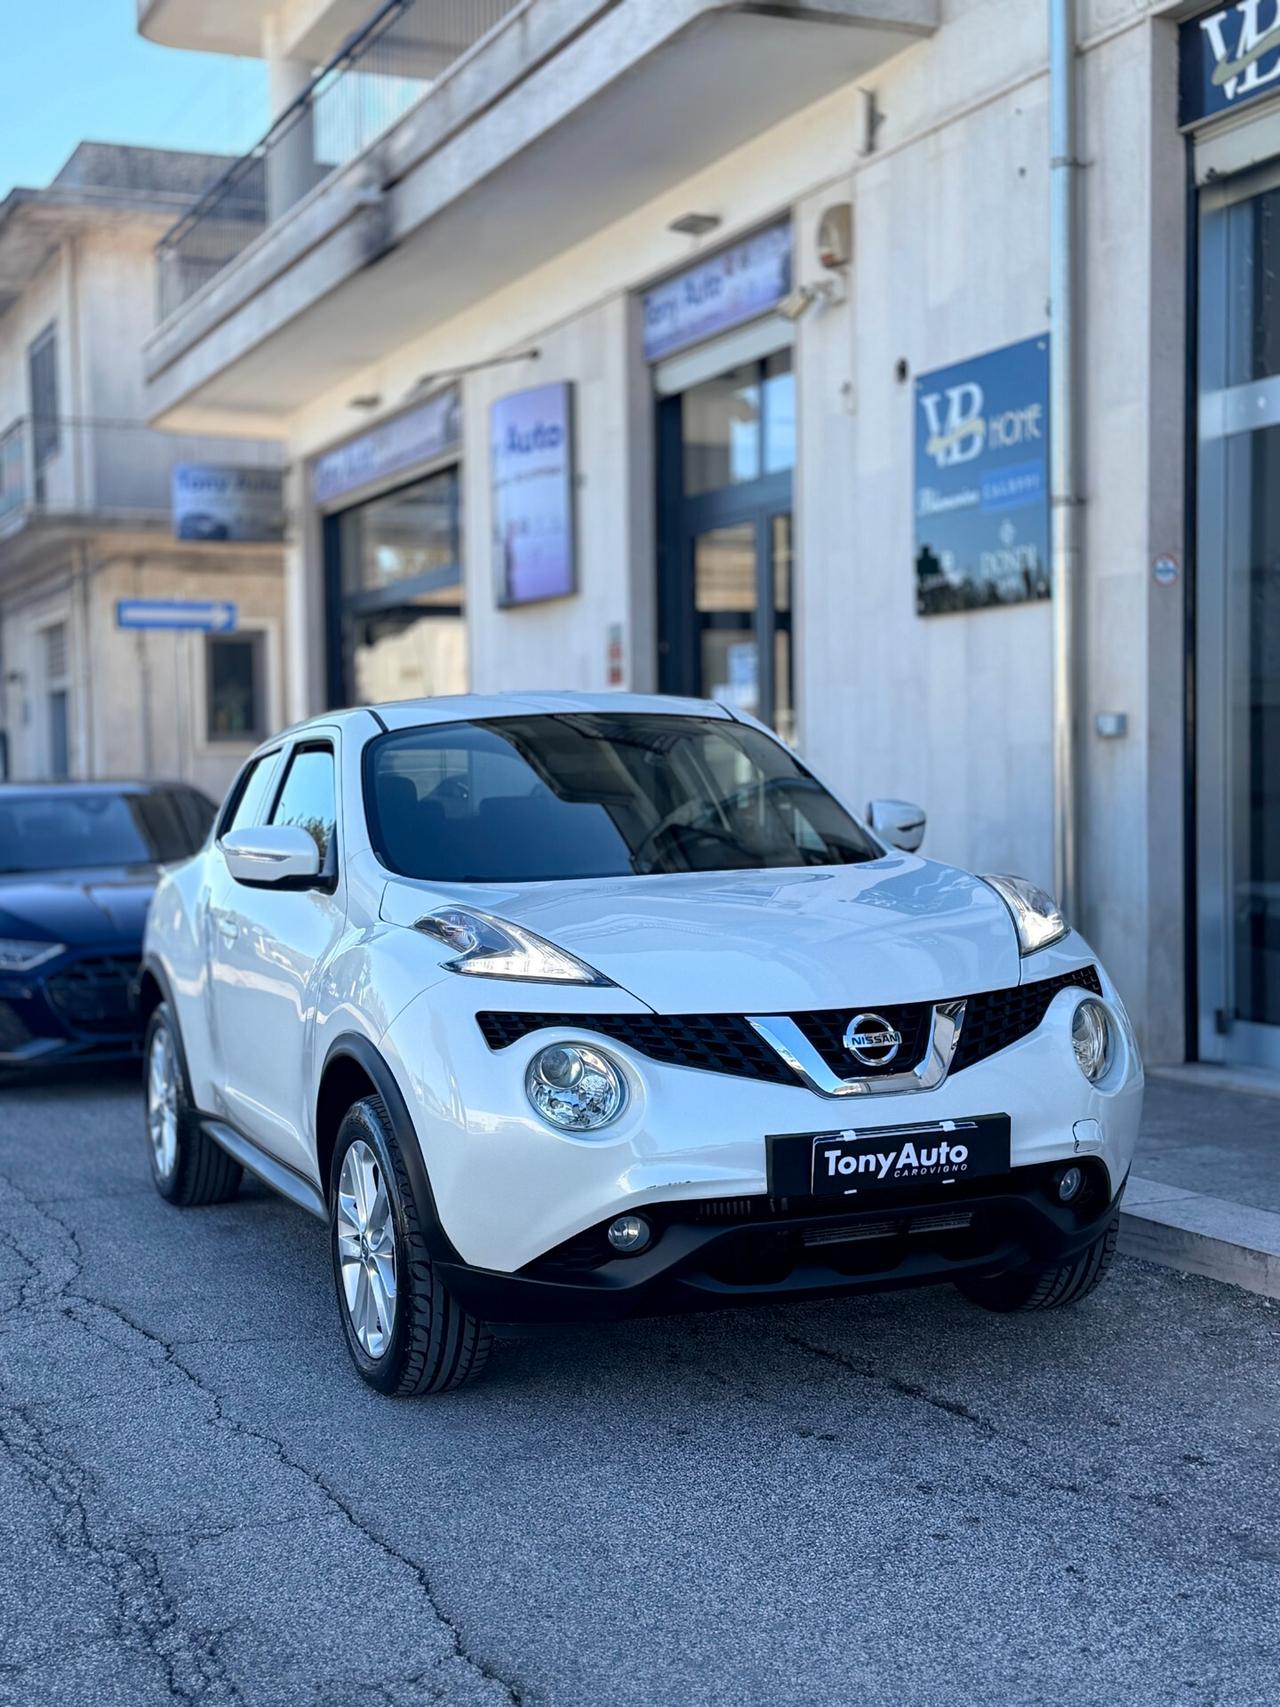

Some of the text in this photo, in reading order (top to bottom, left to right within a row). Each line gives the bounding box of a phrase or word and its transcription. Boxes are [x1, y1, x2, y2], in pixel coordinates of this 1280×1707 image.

[505, 421, 564, 455] Auto
[178, 469, 228, 494] Tony
[851, 1032, 898, 1046] NISSAN
[893, 1164, 969, 1178] CAROVIGNO
